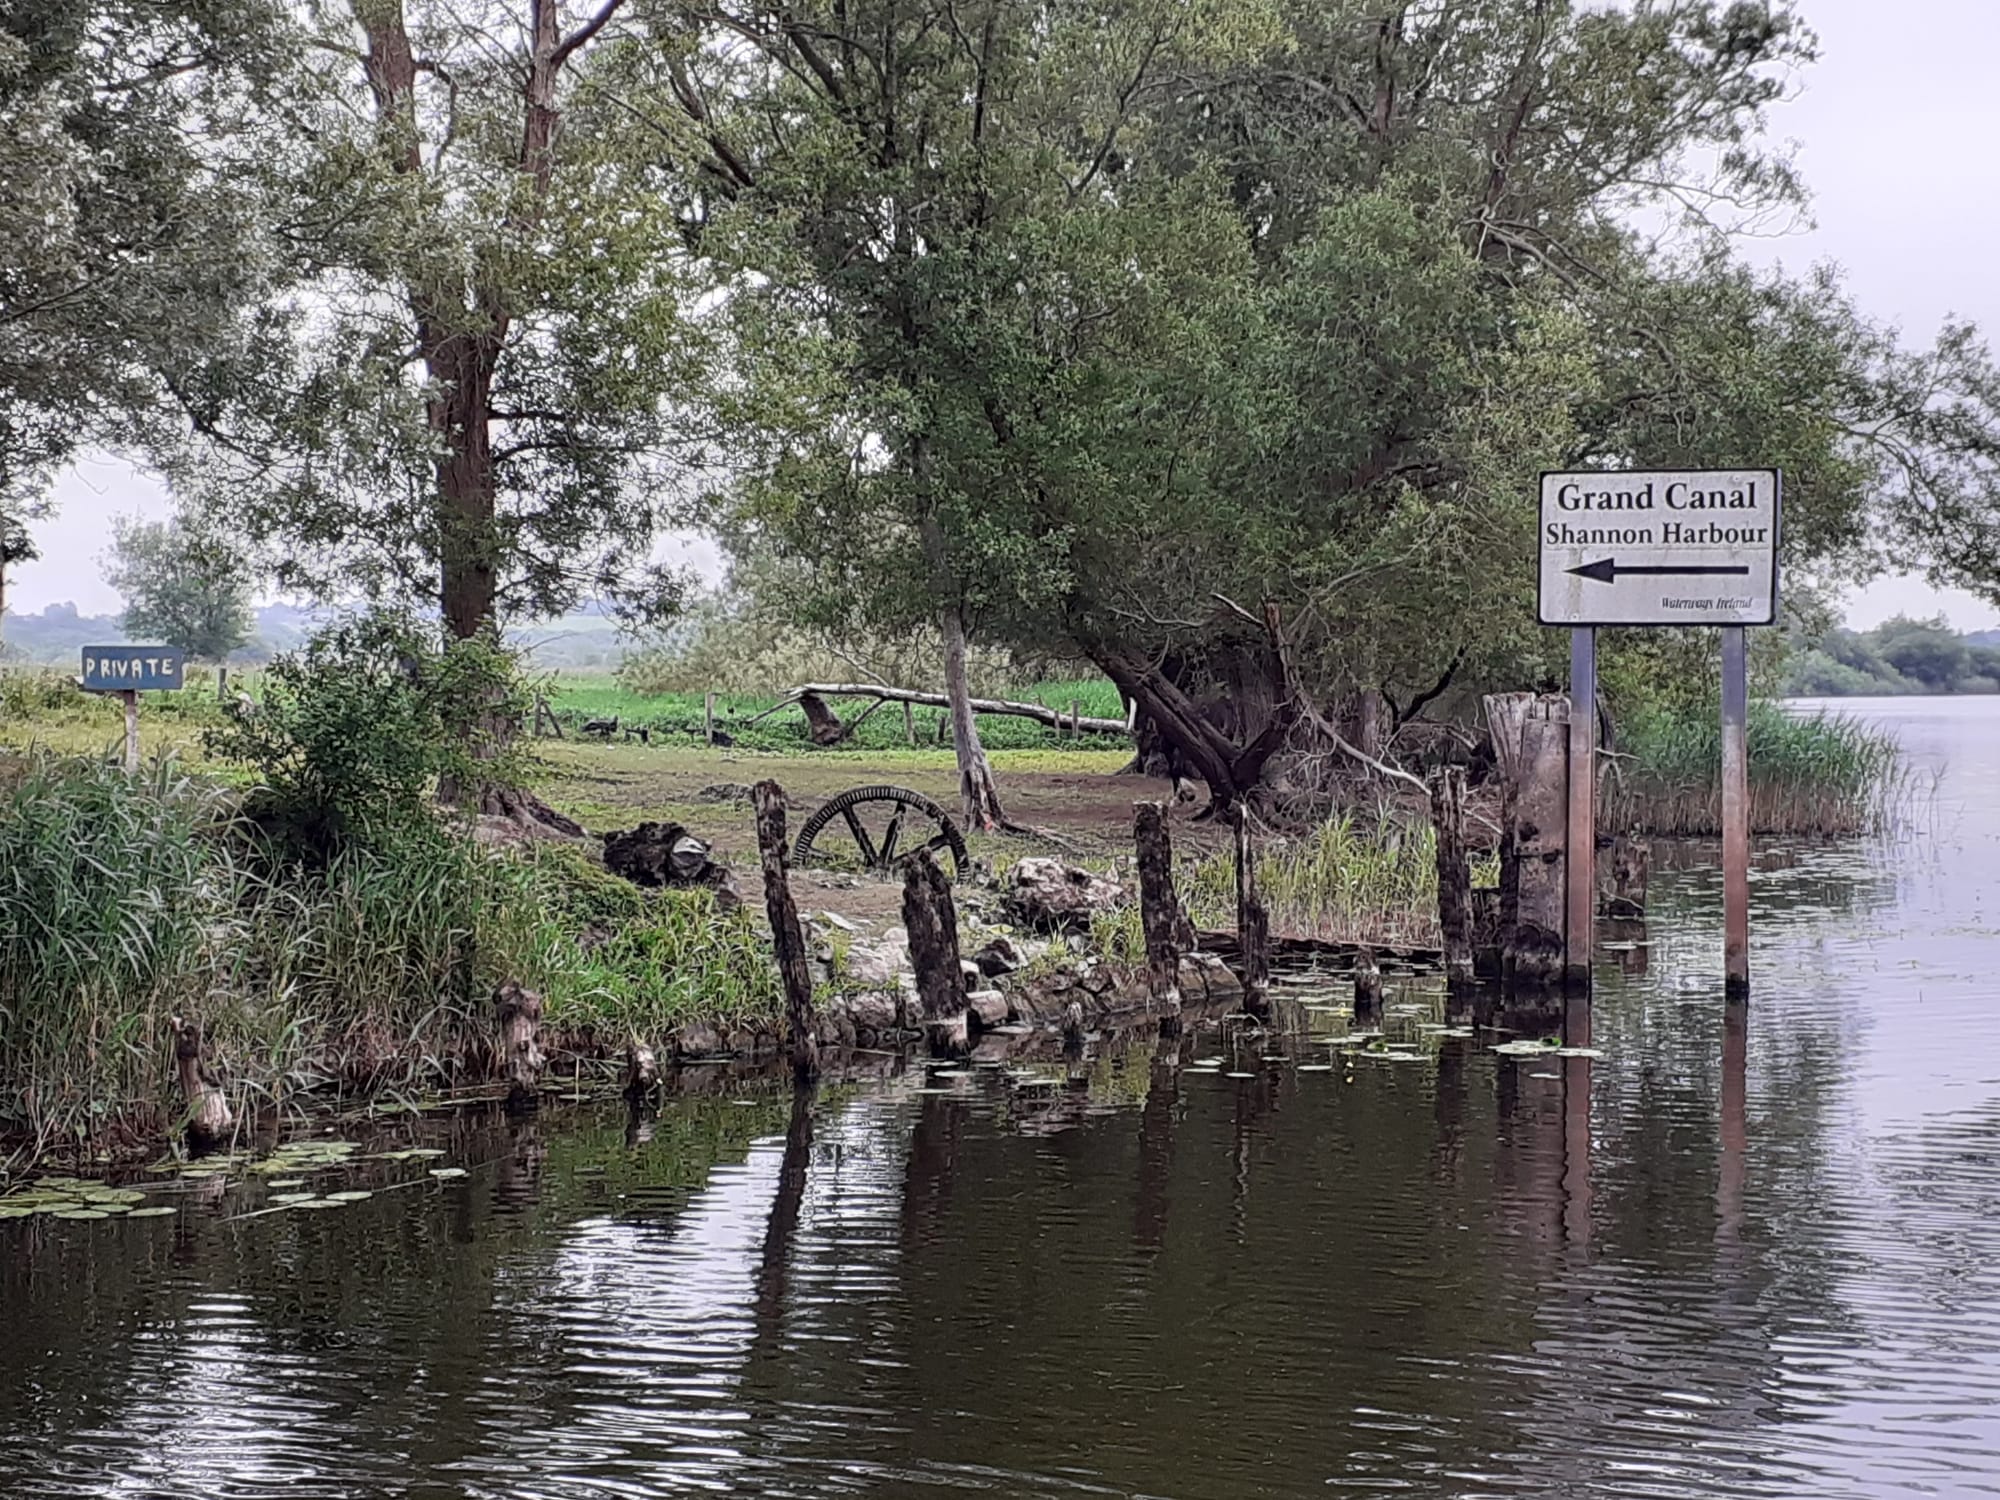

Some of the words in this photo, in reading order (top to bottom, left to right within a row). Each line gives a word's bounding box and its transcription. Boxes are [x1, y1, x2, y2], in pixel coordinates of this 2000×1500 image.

[1557, 482, 1654, 511] Grand
[1665, 481, 1758, 510] Canal
[1546, 522, 1653, 545] Shannon
[1662, 521, 1768, 544] Harbour
[1661, 597, 1714, 611] Waterways
[1715, 597, 1753, 610] Ireland
[86, 657, 174, 679] PRIVATE
